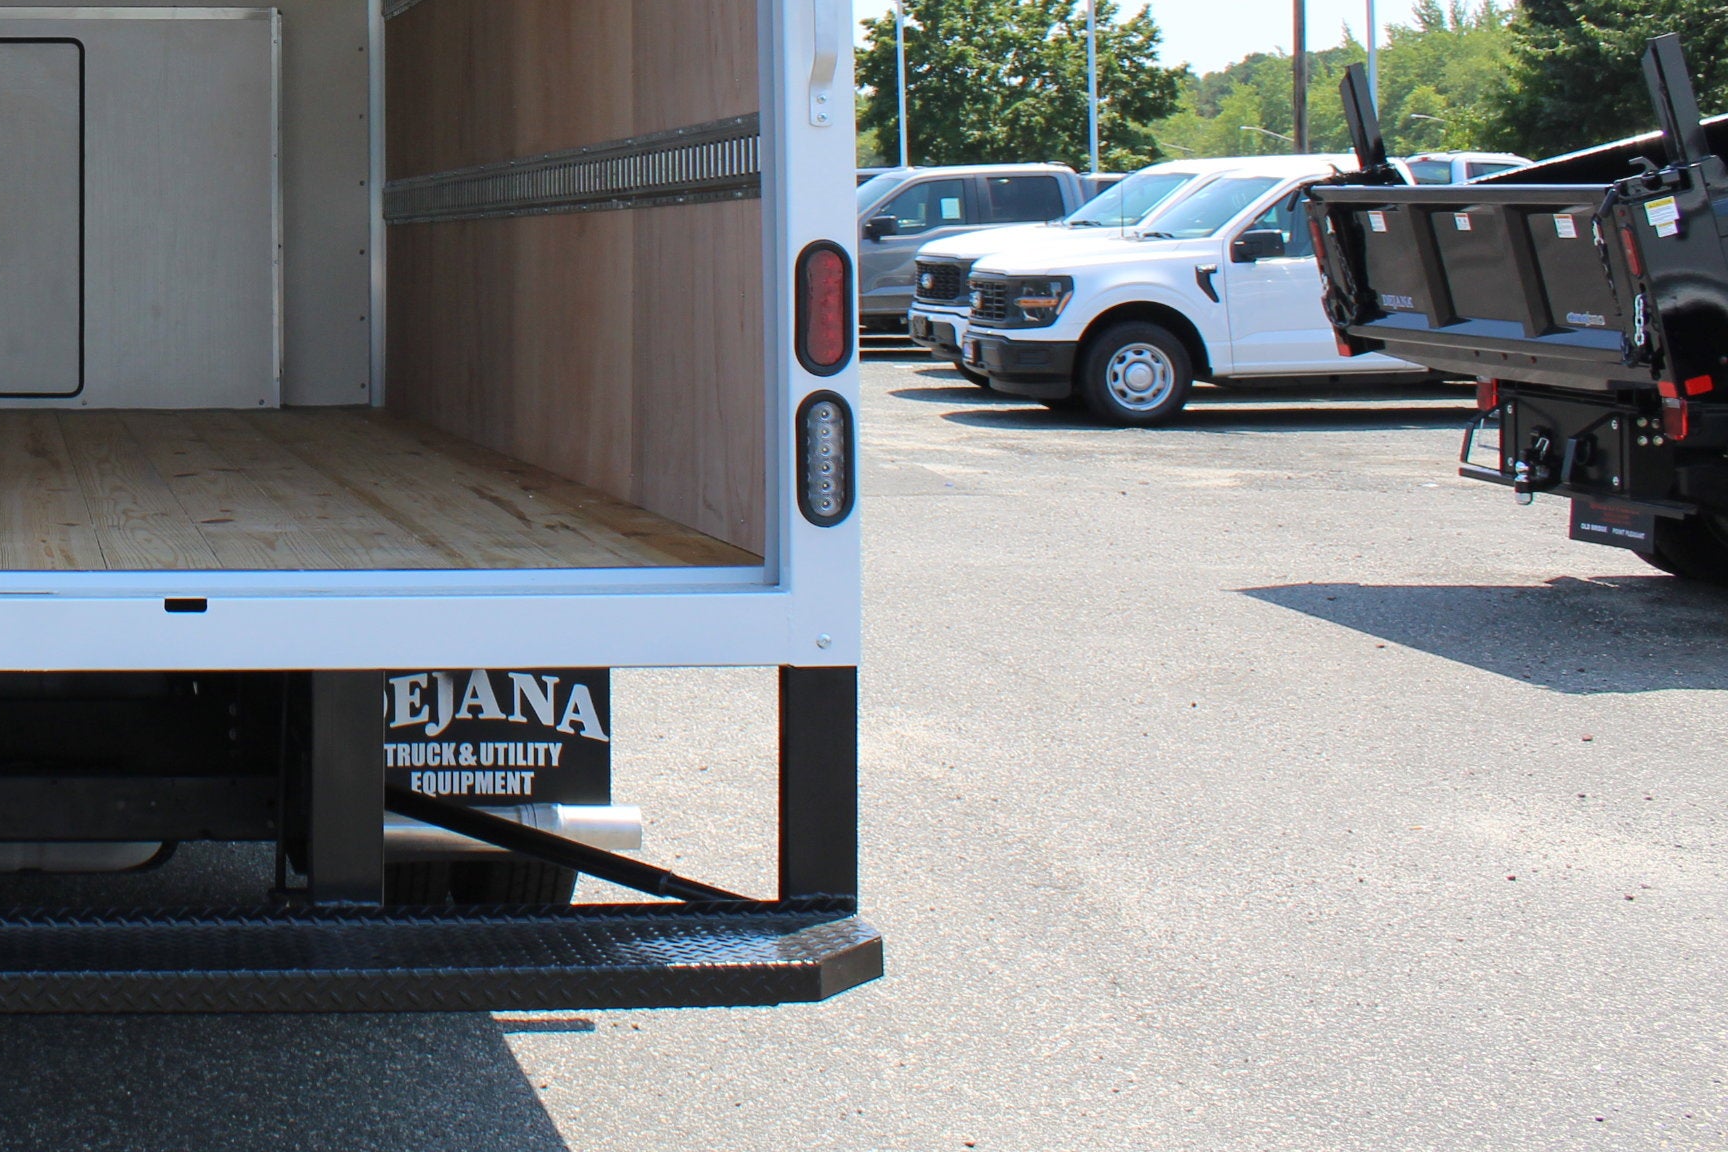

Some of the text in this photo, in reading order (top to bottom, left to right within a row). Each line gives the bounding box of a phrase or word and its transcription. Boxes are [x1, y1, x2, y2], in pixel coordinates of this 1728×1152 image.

[384, 669, 610, 742] EJANA
[384, 742, 563, 768] TRUCK & UTILITY
[410, 771, 535, 797] EQUIPMENT
